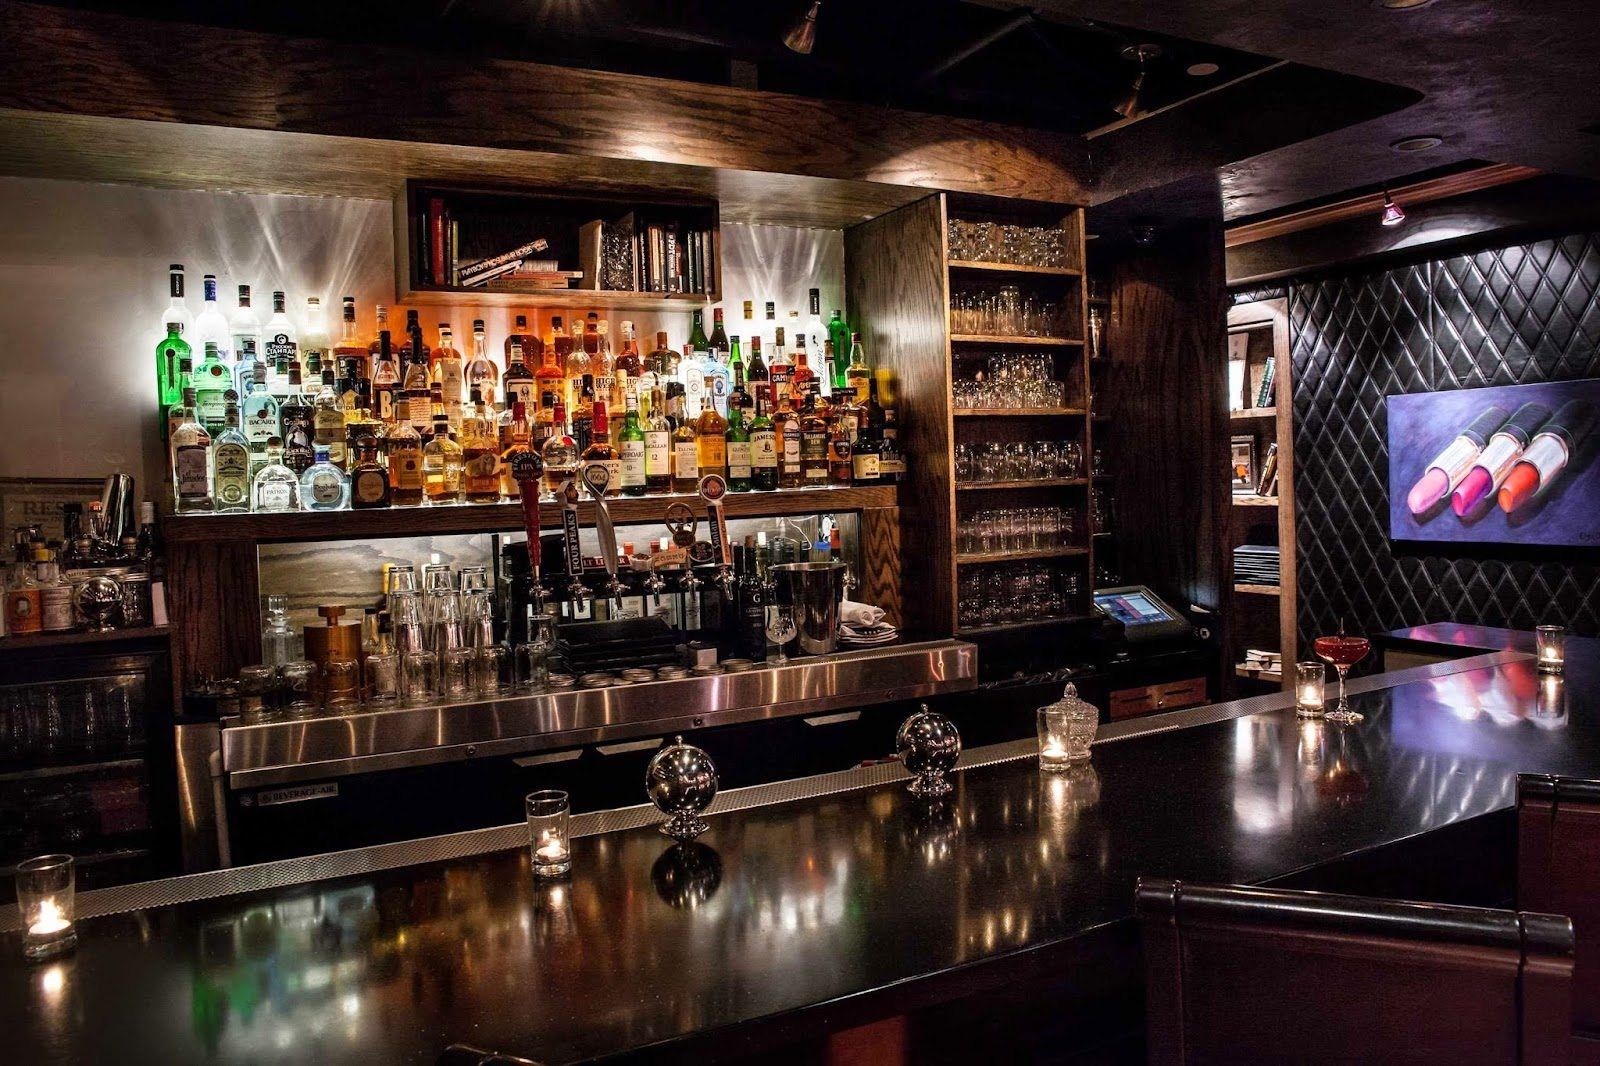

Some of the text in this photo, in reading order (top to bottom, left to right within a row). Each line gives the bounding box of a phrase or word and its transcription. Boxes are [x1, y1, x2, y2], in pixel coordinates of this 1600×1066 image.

[513, 453, 542, 471] FIRESTONE
[520, 463, 534, 471] IPA
[567, 513, 580, 570] FOUR PEAKS
[753, 593, 761, 603] G
[273, 785, 336, 800] BEVERAGE-AIR
